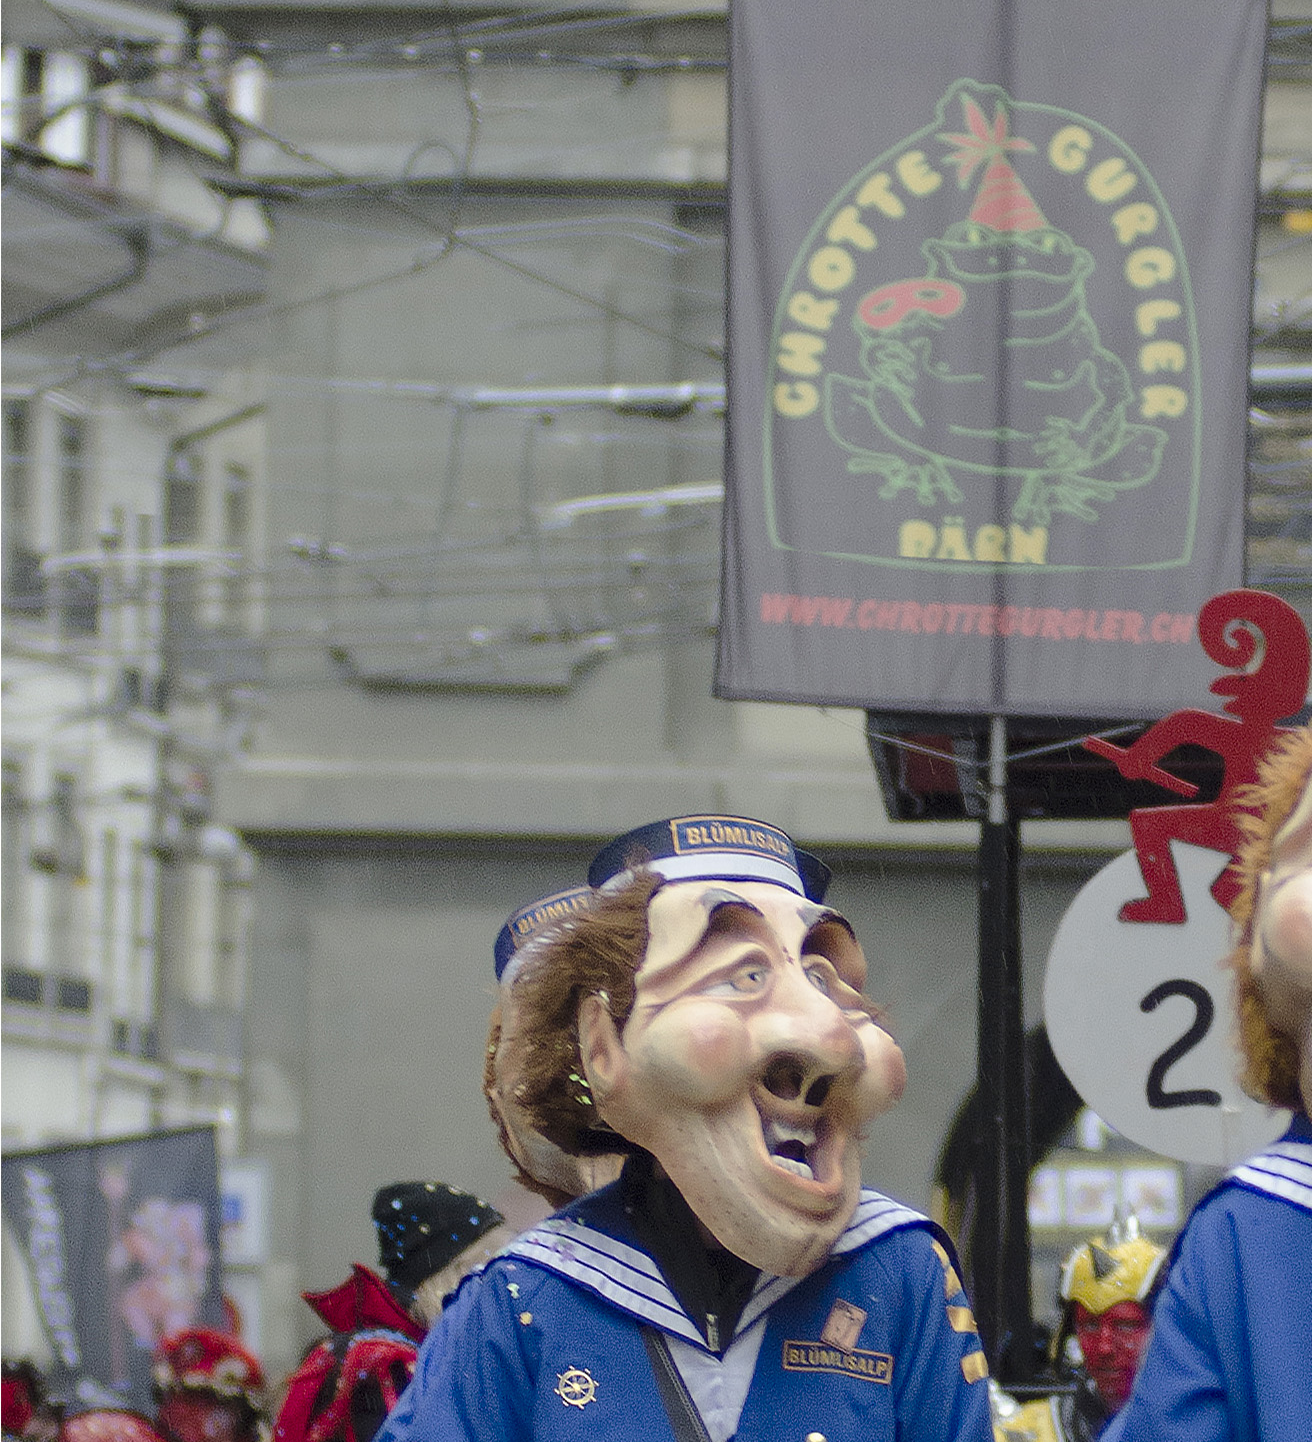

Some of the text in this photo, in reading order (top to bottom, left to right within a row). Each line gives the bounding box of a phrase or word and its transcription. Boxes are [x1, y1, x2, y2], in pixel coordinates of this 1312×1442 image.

[774, 150, 944, 417] CHROTTE
[1048, 125, 1188, 419] GURGLER
[1140, 978, 1222, 1109] 2
